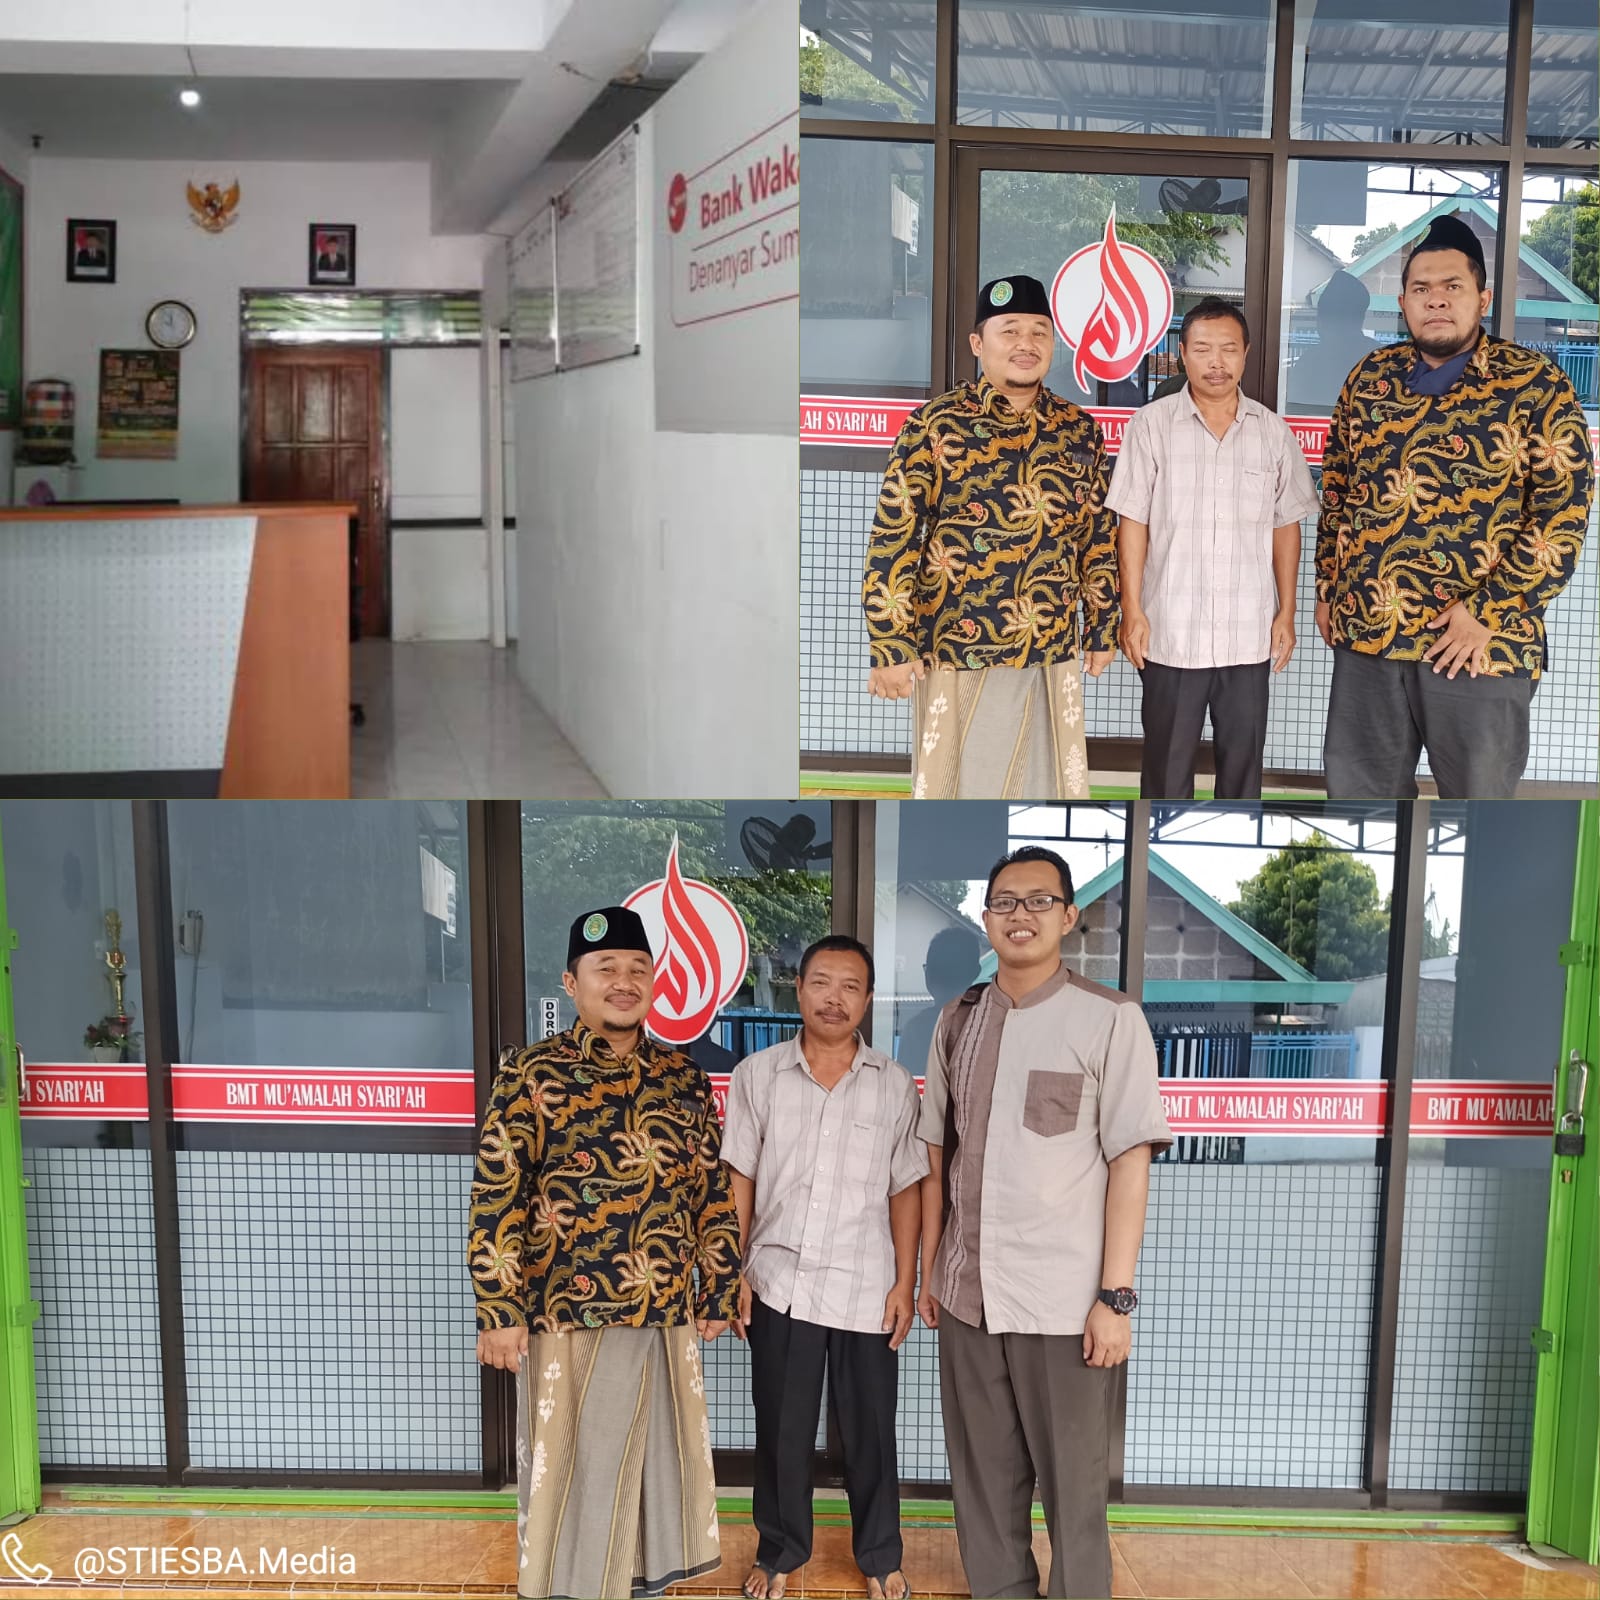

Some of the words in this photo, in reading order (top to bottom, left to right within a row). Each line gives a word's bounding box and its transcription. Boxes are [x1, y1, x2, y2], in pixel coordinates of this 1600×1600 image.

[700, 173, 743, 230] Bank
[689, 246, 756, 292] Denanyar
[826, 411, 887, 433] SYARI'AH
[1296, 430, 1324, 450] BMT
[36, 1080, 105, 1103] SYARI'AH
[226, 1082, 259, 1105] BMT
[263, 1083, 352, 1107] MU'AMALAH
[357, 1085, 426, 1108] SYARI'AH
[1161, 1095, 1193, 1118] BMT
[1197, 1095, 1287, 1119] MU'AMALAH
[1292, 1096, 1363, 1120] SYARI'AH
[1428, 1097, 1462, 1120] BMT
